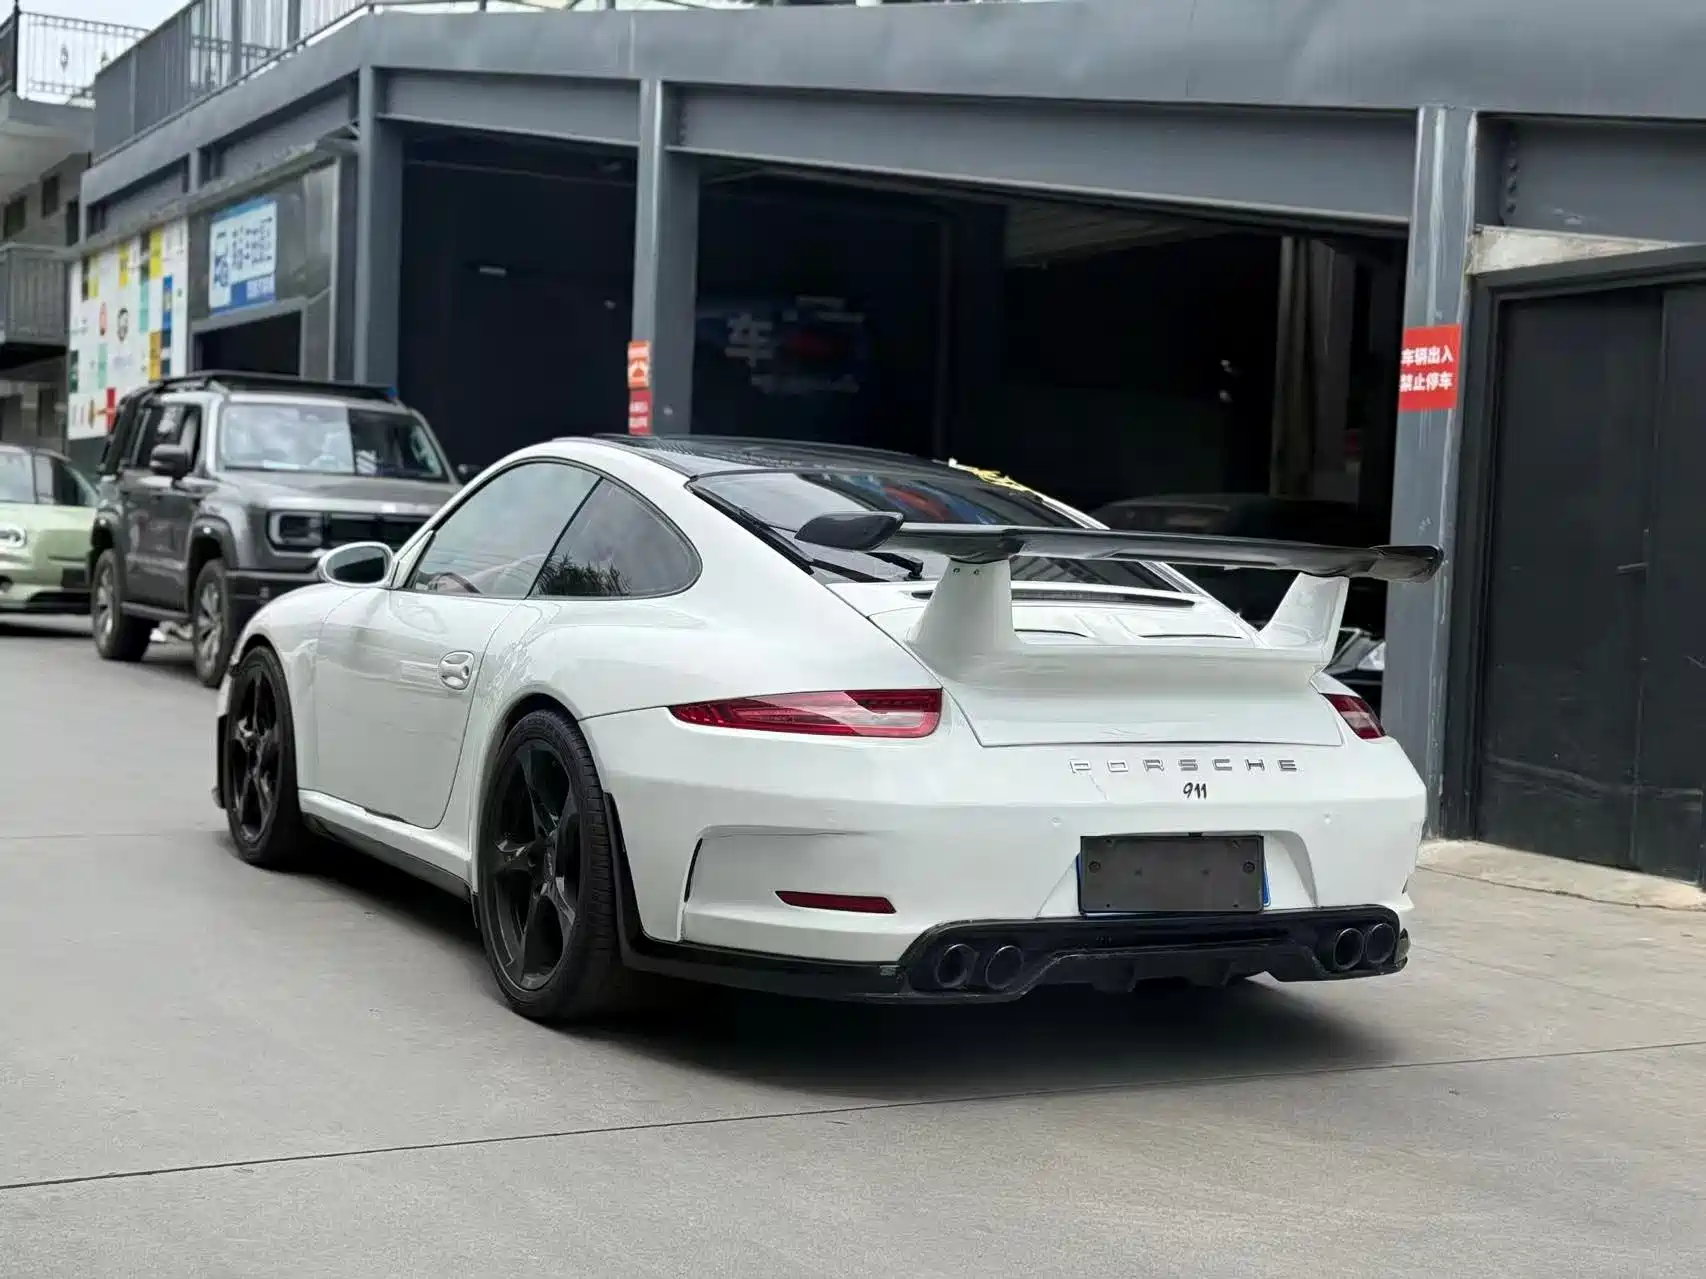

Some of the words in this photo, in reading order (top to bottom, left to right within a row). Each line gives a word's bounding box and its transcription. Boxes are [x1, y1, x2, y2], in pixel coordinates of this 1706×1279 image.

[1401, 345, 1454, 366] 车辆出入
[1068, 757, 1298, 774] PORSCHE
[1182, 781, 1208, 800] 911
